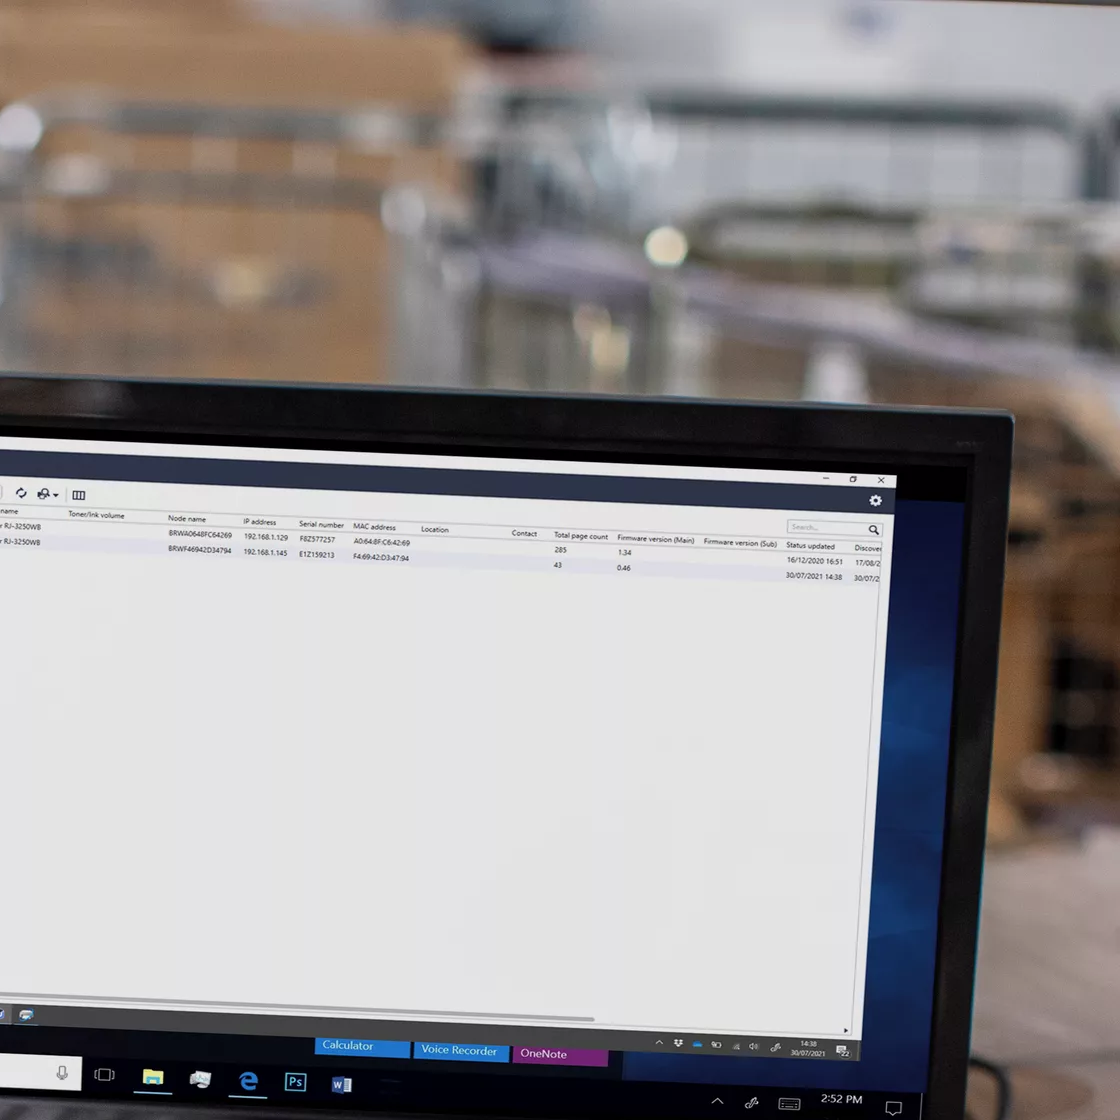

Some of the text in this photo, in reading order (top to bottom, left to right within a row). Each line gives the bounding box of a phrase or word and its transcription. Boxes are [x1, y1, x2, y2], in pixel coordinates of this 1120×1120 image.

[68, 510, 99, 518] Toner/Ink
[244, 533, 288, 542] 192.168.1.129
[512, 530, 538, 538] Contact
[572, 533, 588, 541] page
[617, 534, 647, 542] Firmware
[674, 536, 694, 544] (Main)
[760, 540, 778, 548] (Sub)
[808, 543, 835, 551] updated
[244, 548, 288, 557] 192.168.1.145
[788, 556, 825, 564] 16/12/2020
[856, 560, 880, 568] 17/08/2
[786, 572, 823, 580] 30/07/2021
[854, 574, 880, 582] 30/07/2
[322, 1040, 374, 1051] Calculator
[421, 1044, 497, 1057] Voice Recorder
[520, 1048, 567, 1060] OneNote
[289, 1076, 302, 1087] Ps
[821, 1094, 863, 1104] 2:52 PM
